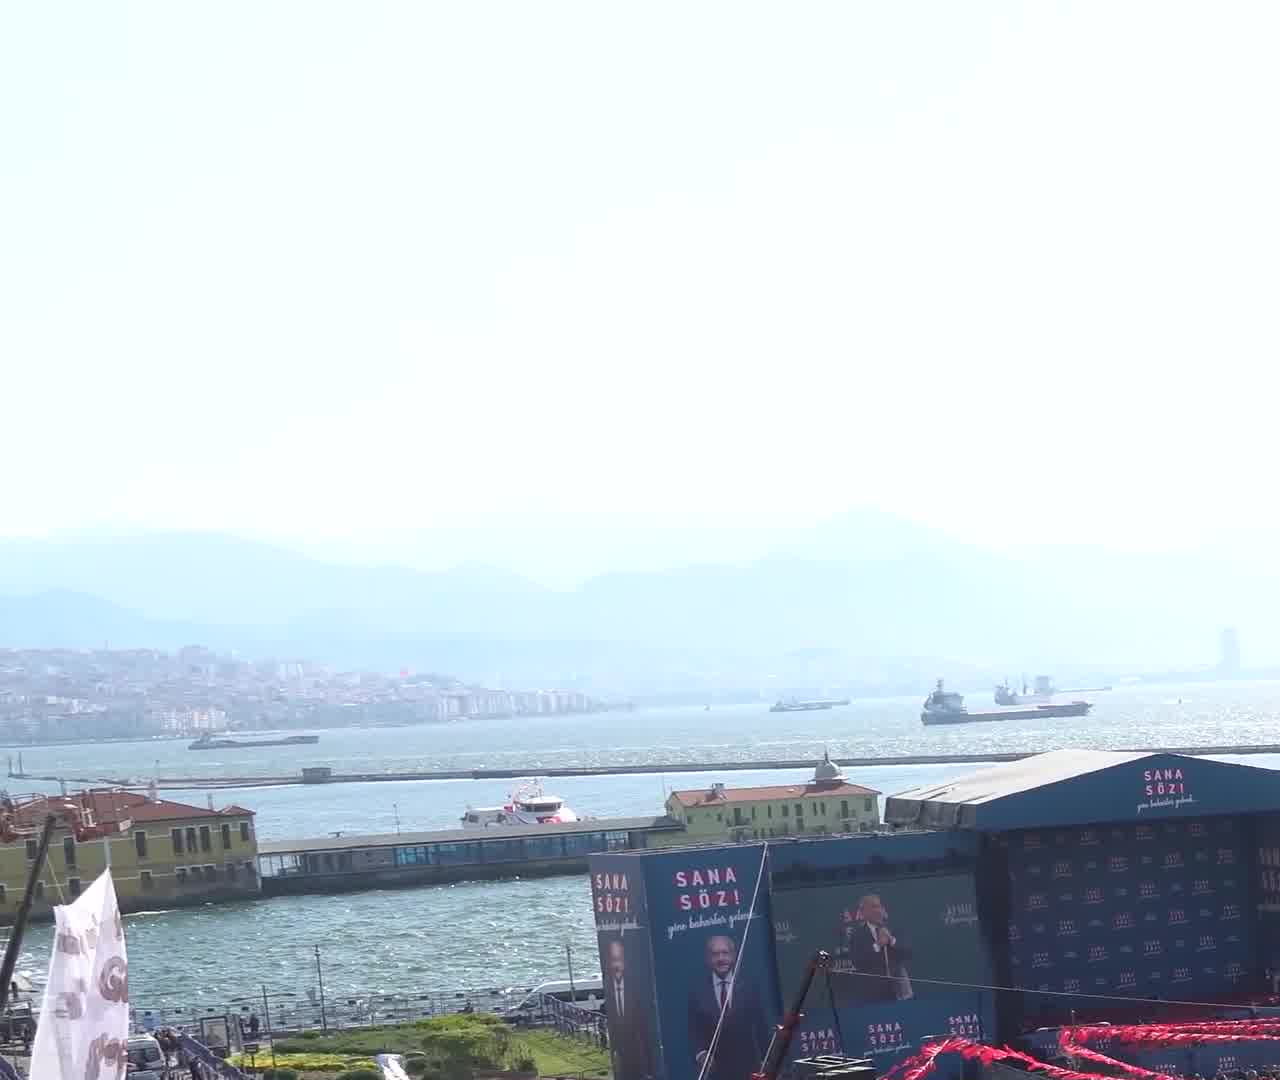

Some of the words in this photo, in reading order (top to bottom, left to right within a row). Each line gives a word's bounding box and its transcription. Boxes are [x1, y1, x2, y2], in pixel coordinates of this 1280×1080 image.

[1144, 769, 1183, 781] SANA
[1145, 782, 1184, 795] SÖZ!
[595, 873, 629, 890] SANA
[675, 867, 737, 888] SANA
[597, 894, 629, 913] SÖZ!
[679, 889, 741, 911] SÖZ!
